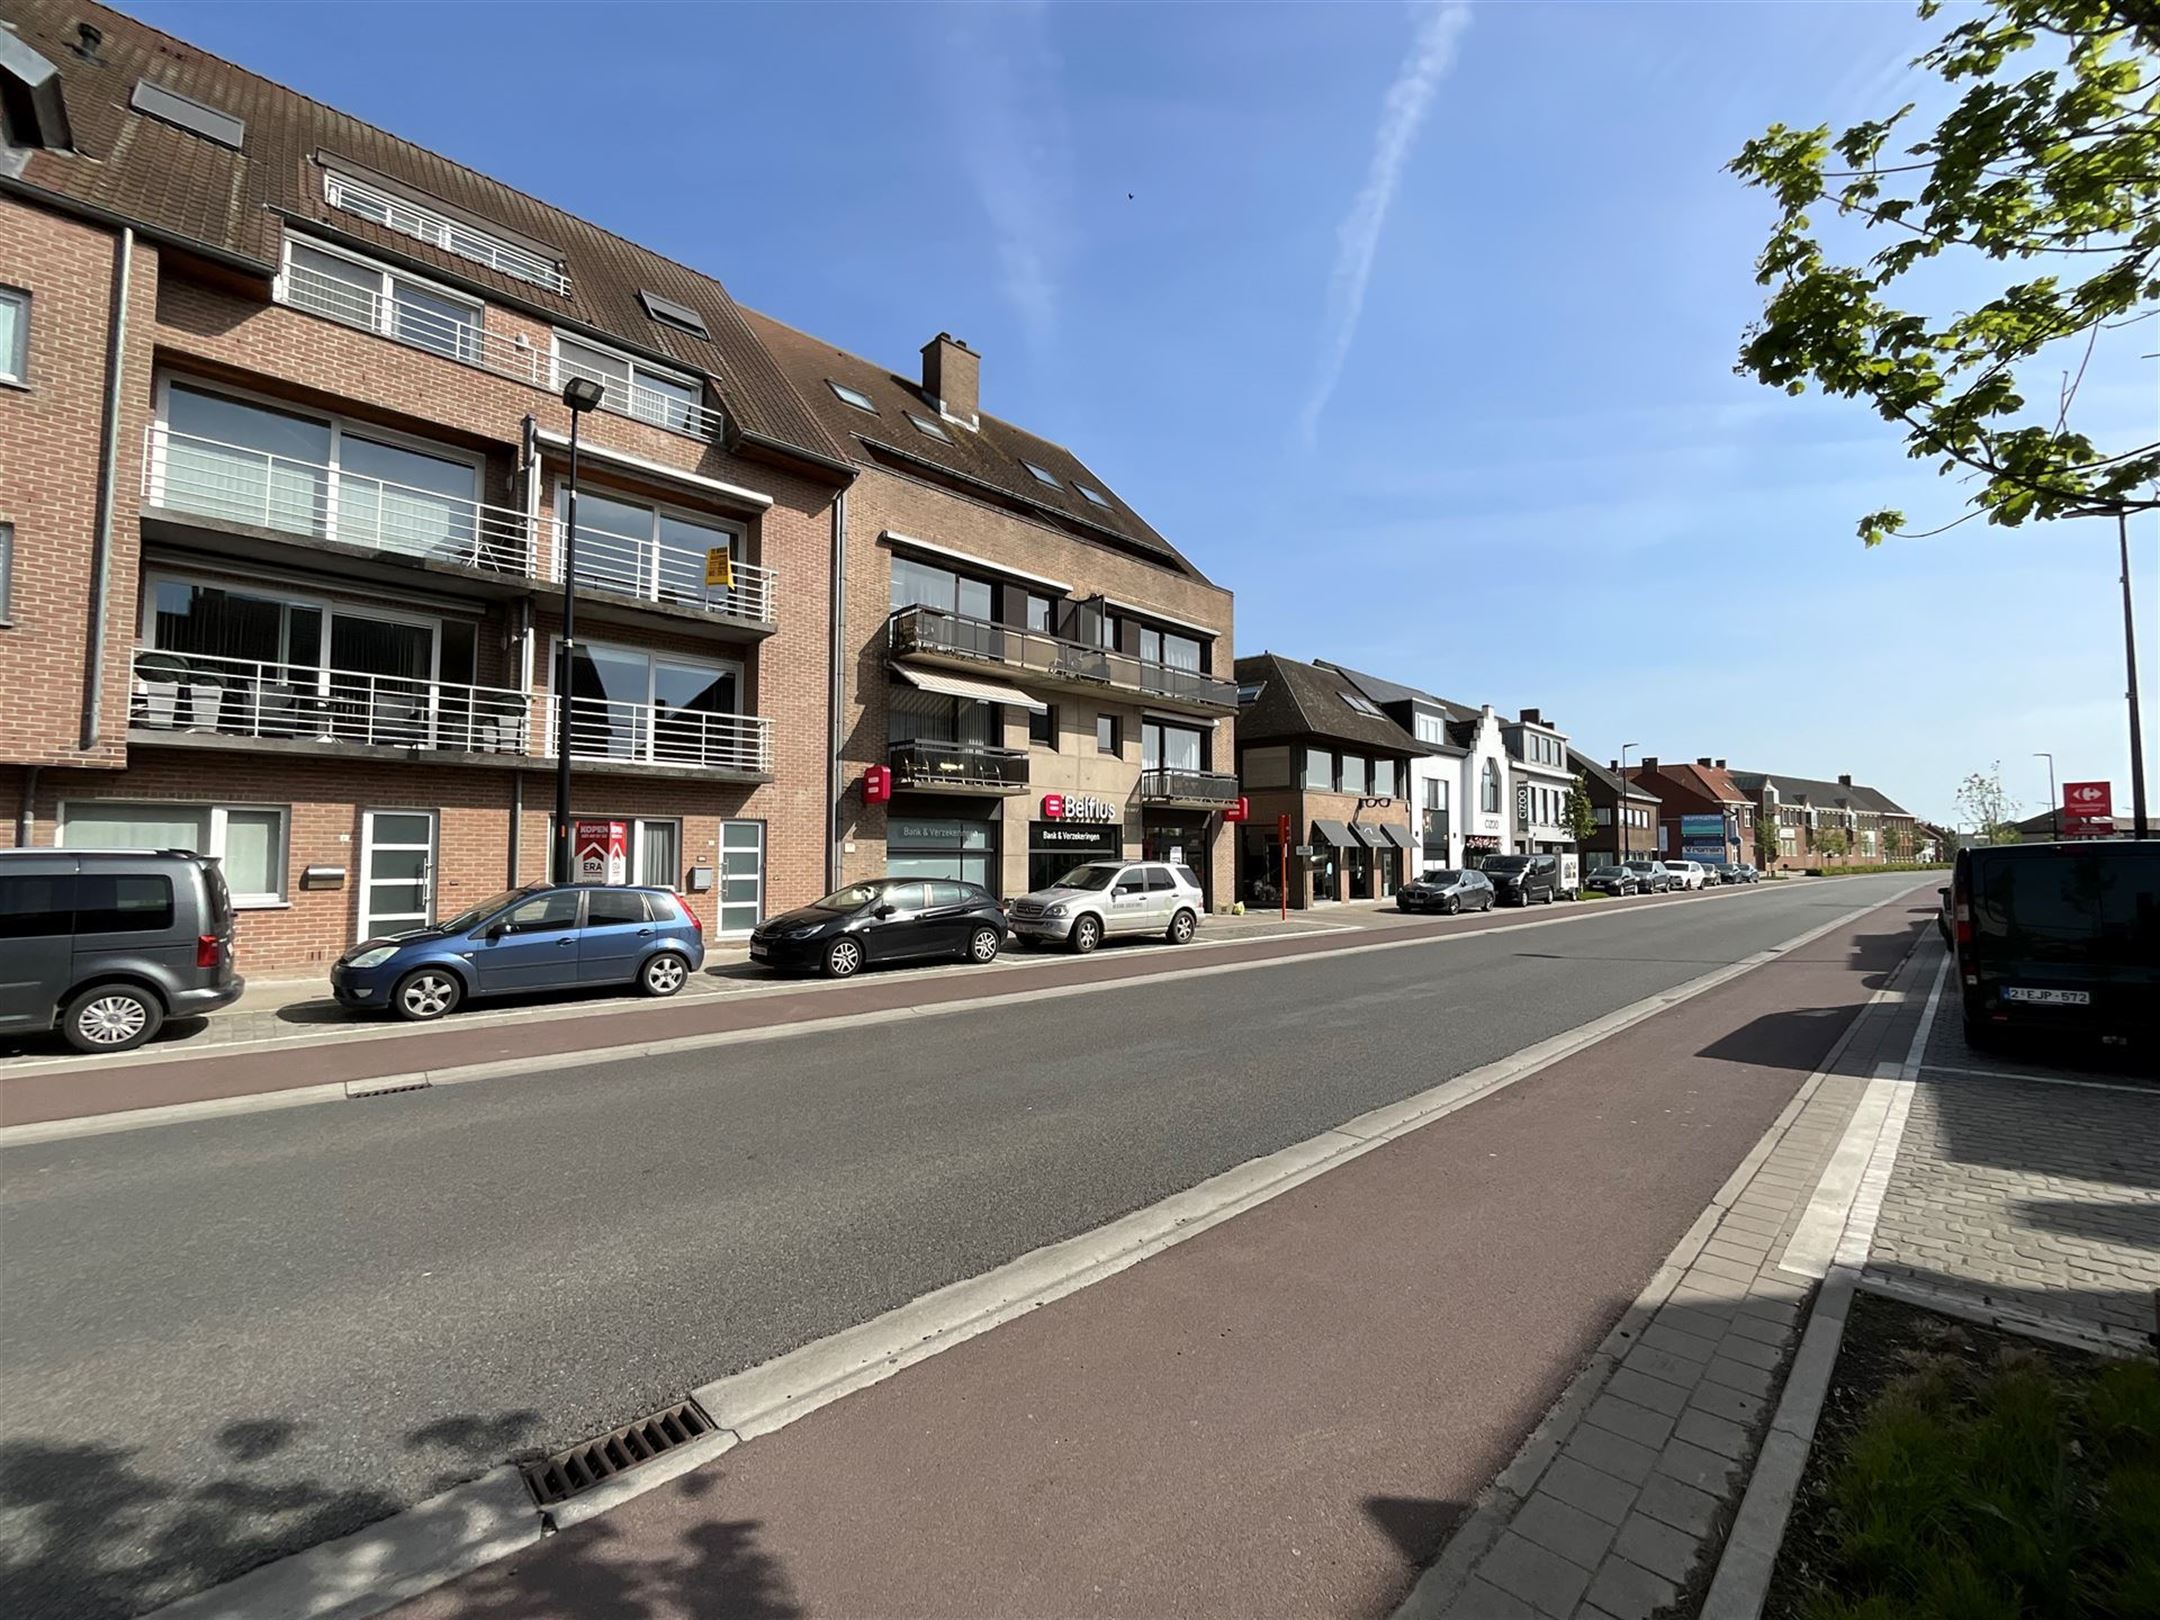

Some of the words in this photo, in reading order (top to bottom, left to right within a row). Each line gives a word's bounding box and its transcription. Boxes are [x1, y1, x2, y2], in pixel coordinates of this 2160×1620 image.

[1065, 795, 1116, 819] Belfius
[1518, 789, 1527, 819] CIZOO
[580, 825, 609, 834] KOPEN
[903, 826, 922, 837] Bank
[1043, 831, 1057, 840] Bank
[1062, 831, 1101, 842] Verzekeringen
[583, 862, 603, 871] ERA
